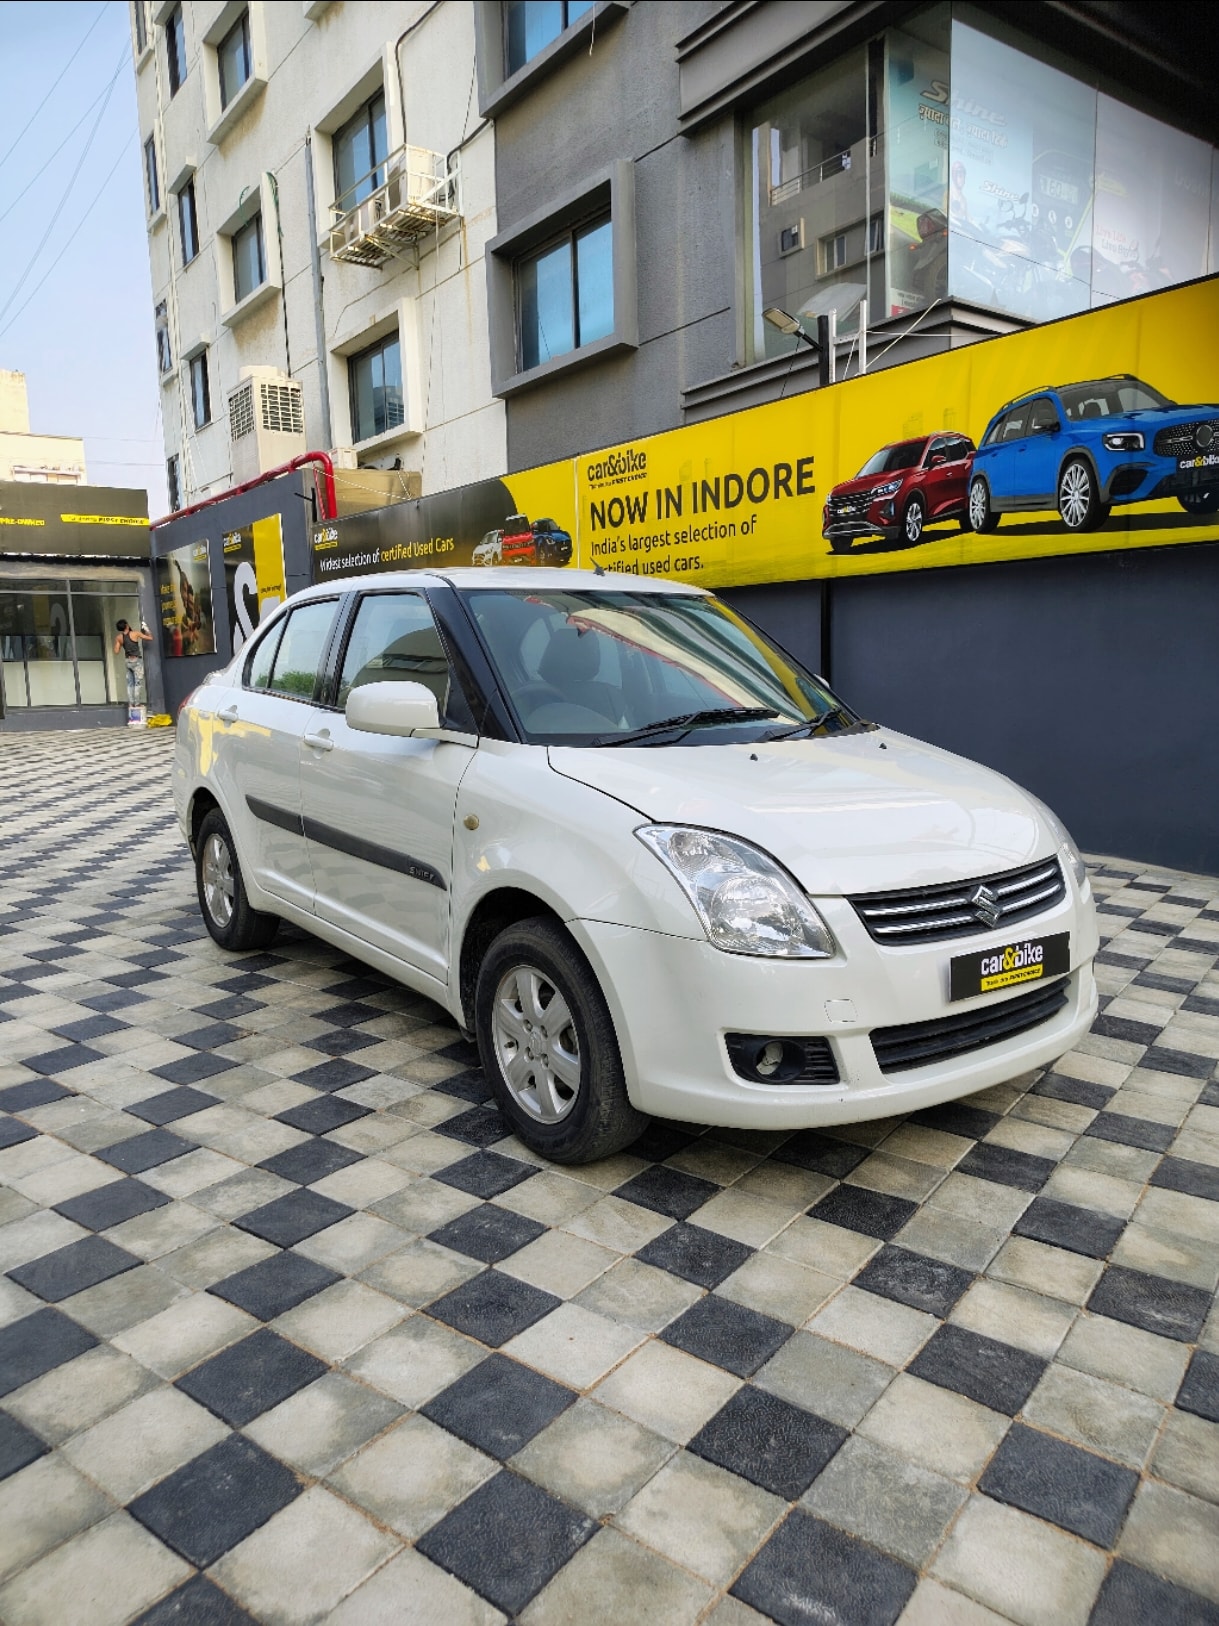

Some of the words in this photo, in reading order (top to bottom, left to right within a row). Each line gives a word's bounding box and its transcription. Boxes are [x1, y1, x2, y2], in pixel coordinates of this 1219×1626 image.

[587, 449, 647, 482] car&bike
[590, 491, 649, 531] NOW
[656, 484, 683, 520] IN
[692, 455, 816, 514] INDORE
[591, 535, 626, 557] India's
[629, 529, 672, 553] largest
[674, 520, 737, 545] selection
[740, 514, 758, 534] of
[320, 555, 341, 573] Widest
[341, 552, 372, 570] selection
[372, 548, 381, 564] of
[381, 543, 413, 562] certified
[413, 539, 434, 557] Used
[436, 537, 455, 553] Cars
[642, 553, 671, 575] used
[674, 555, 704, 572] cars.
[981, 943, 1043, 976] car&bike
